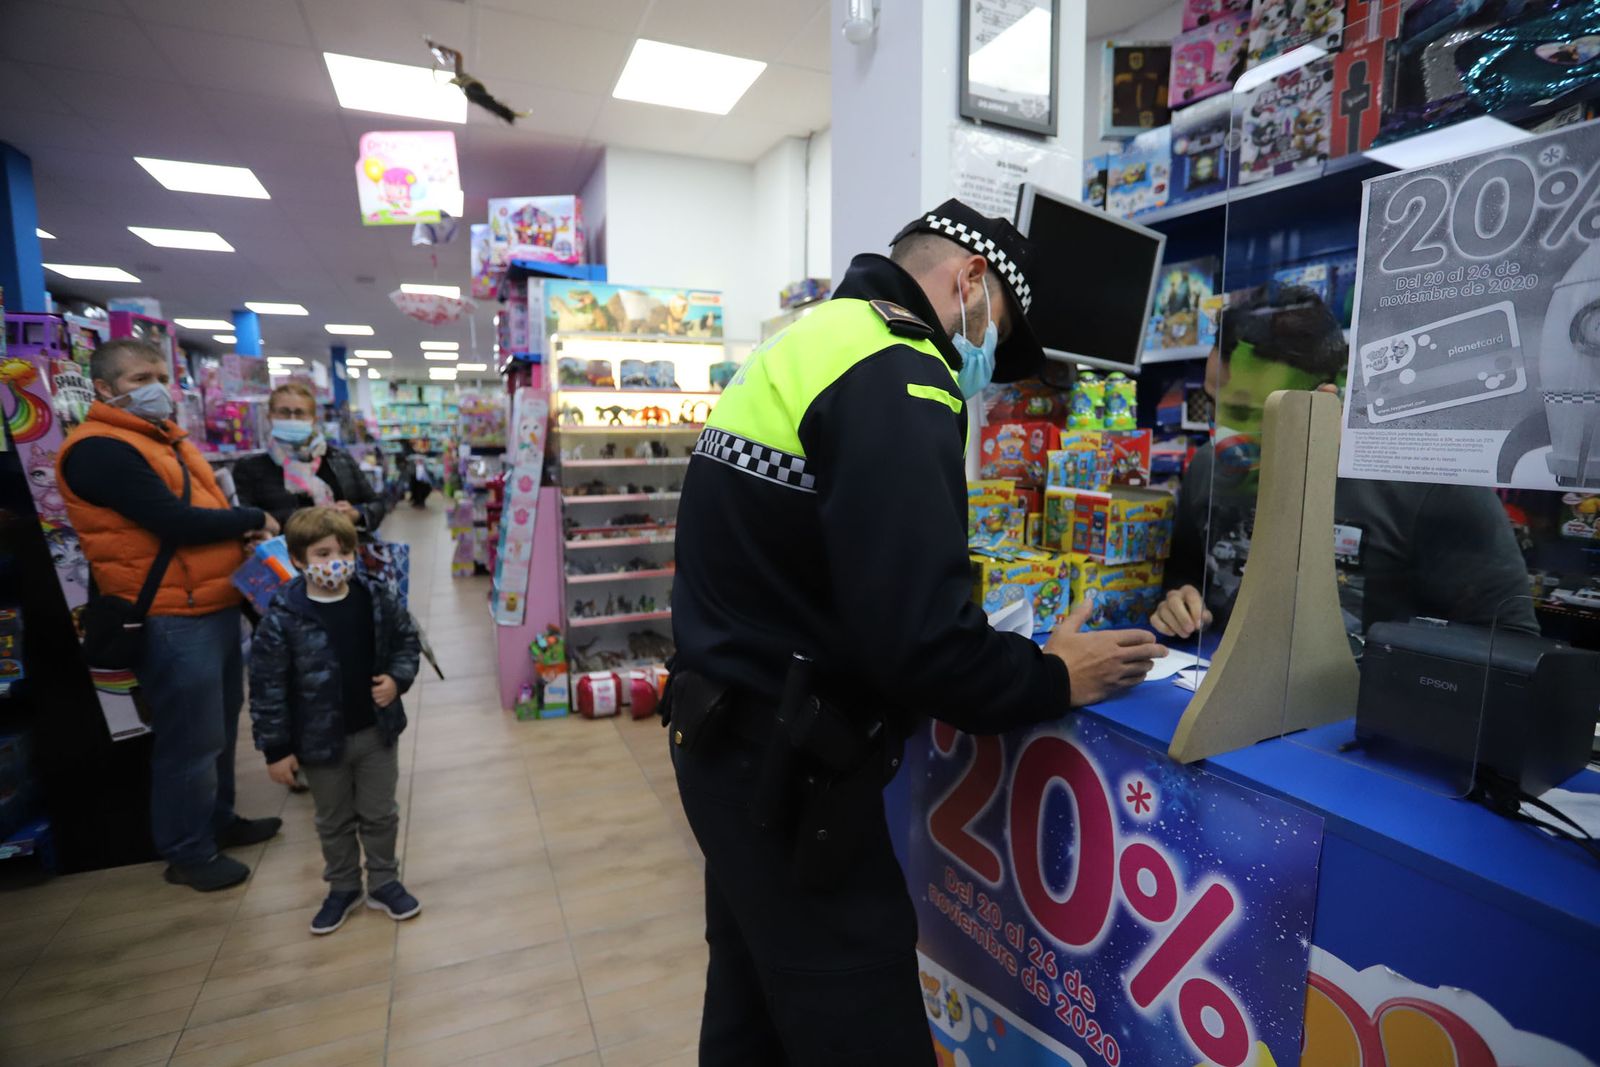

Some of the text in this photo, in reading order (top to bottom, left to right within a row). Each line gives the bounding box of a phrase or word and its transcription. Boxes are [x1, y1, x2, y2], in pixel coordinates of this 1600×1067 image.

[1379, 274, 1538, 307] noviembre de 2020
[1396, 260, 1520, 290] Del 20 al 26 de
[1448, 333, 1503, 358] planetcard
[1420, 676, 1458, 692] EPSON
[945, 866, 1096, 1013] Del 20 al 26 de
[928, 883, 1018, 977] noviembre
[1021, 967, 1051, 1007] de
[1055, 992, 1121, 1067] 2020
